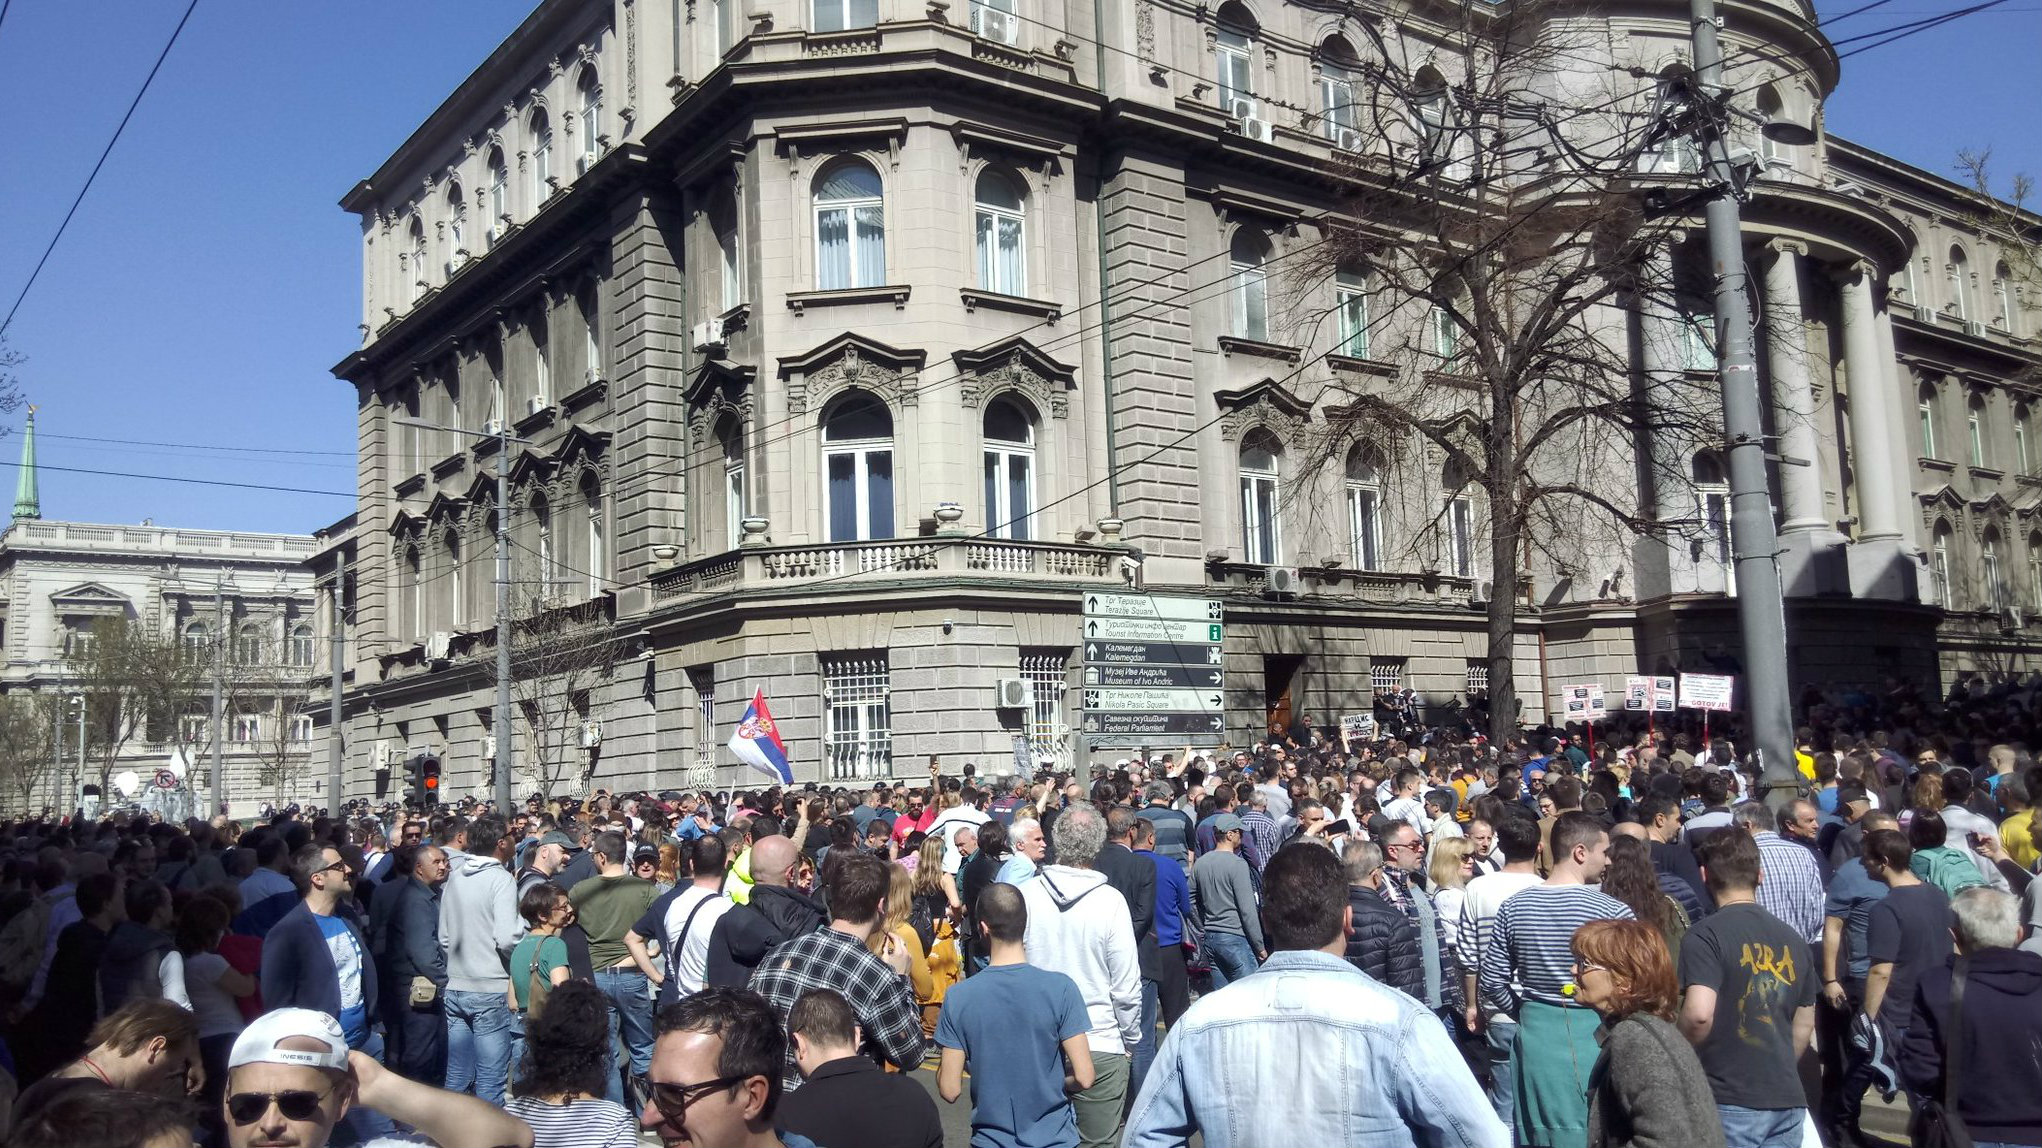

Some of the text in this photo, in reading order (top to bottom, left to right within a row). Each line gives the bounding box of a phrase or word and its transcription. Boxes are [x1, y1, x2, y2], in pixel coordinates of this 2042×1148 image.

[1105, 605, 1154, 616] Terazije Square
[1105, 629, 1185, 640] Tourist Information Centre
[1104, 652, 1146, 662] Kalemegdan
[1104, 677, 1133, 685] Museum
[1134, 677, 1141, 685] of
[1142, 677, 1152, 685] Ivo
[1104, 700, 1126, 709] Nikola
[1146, 700, 1169, 709] Square
[1104, 723, 1165, 732] Federal Parliament
